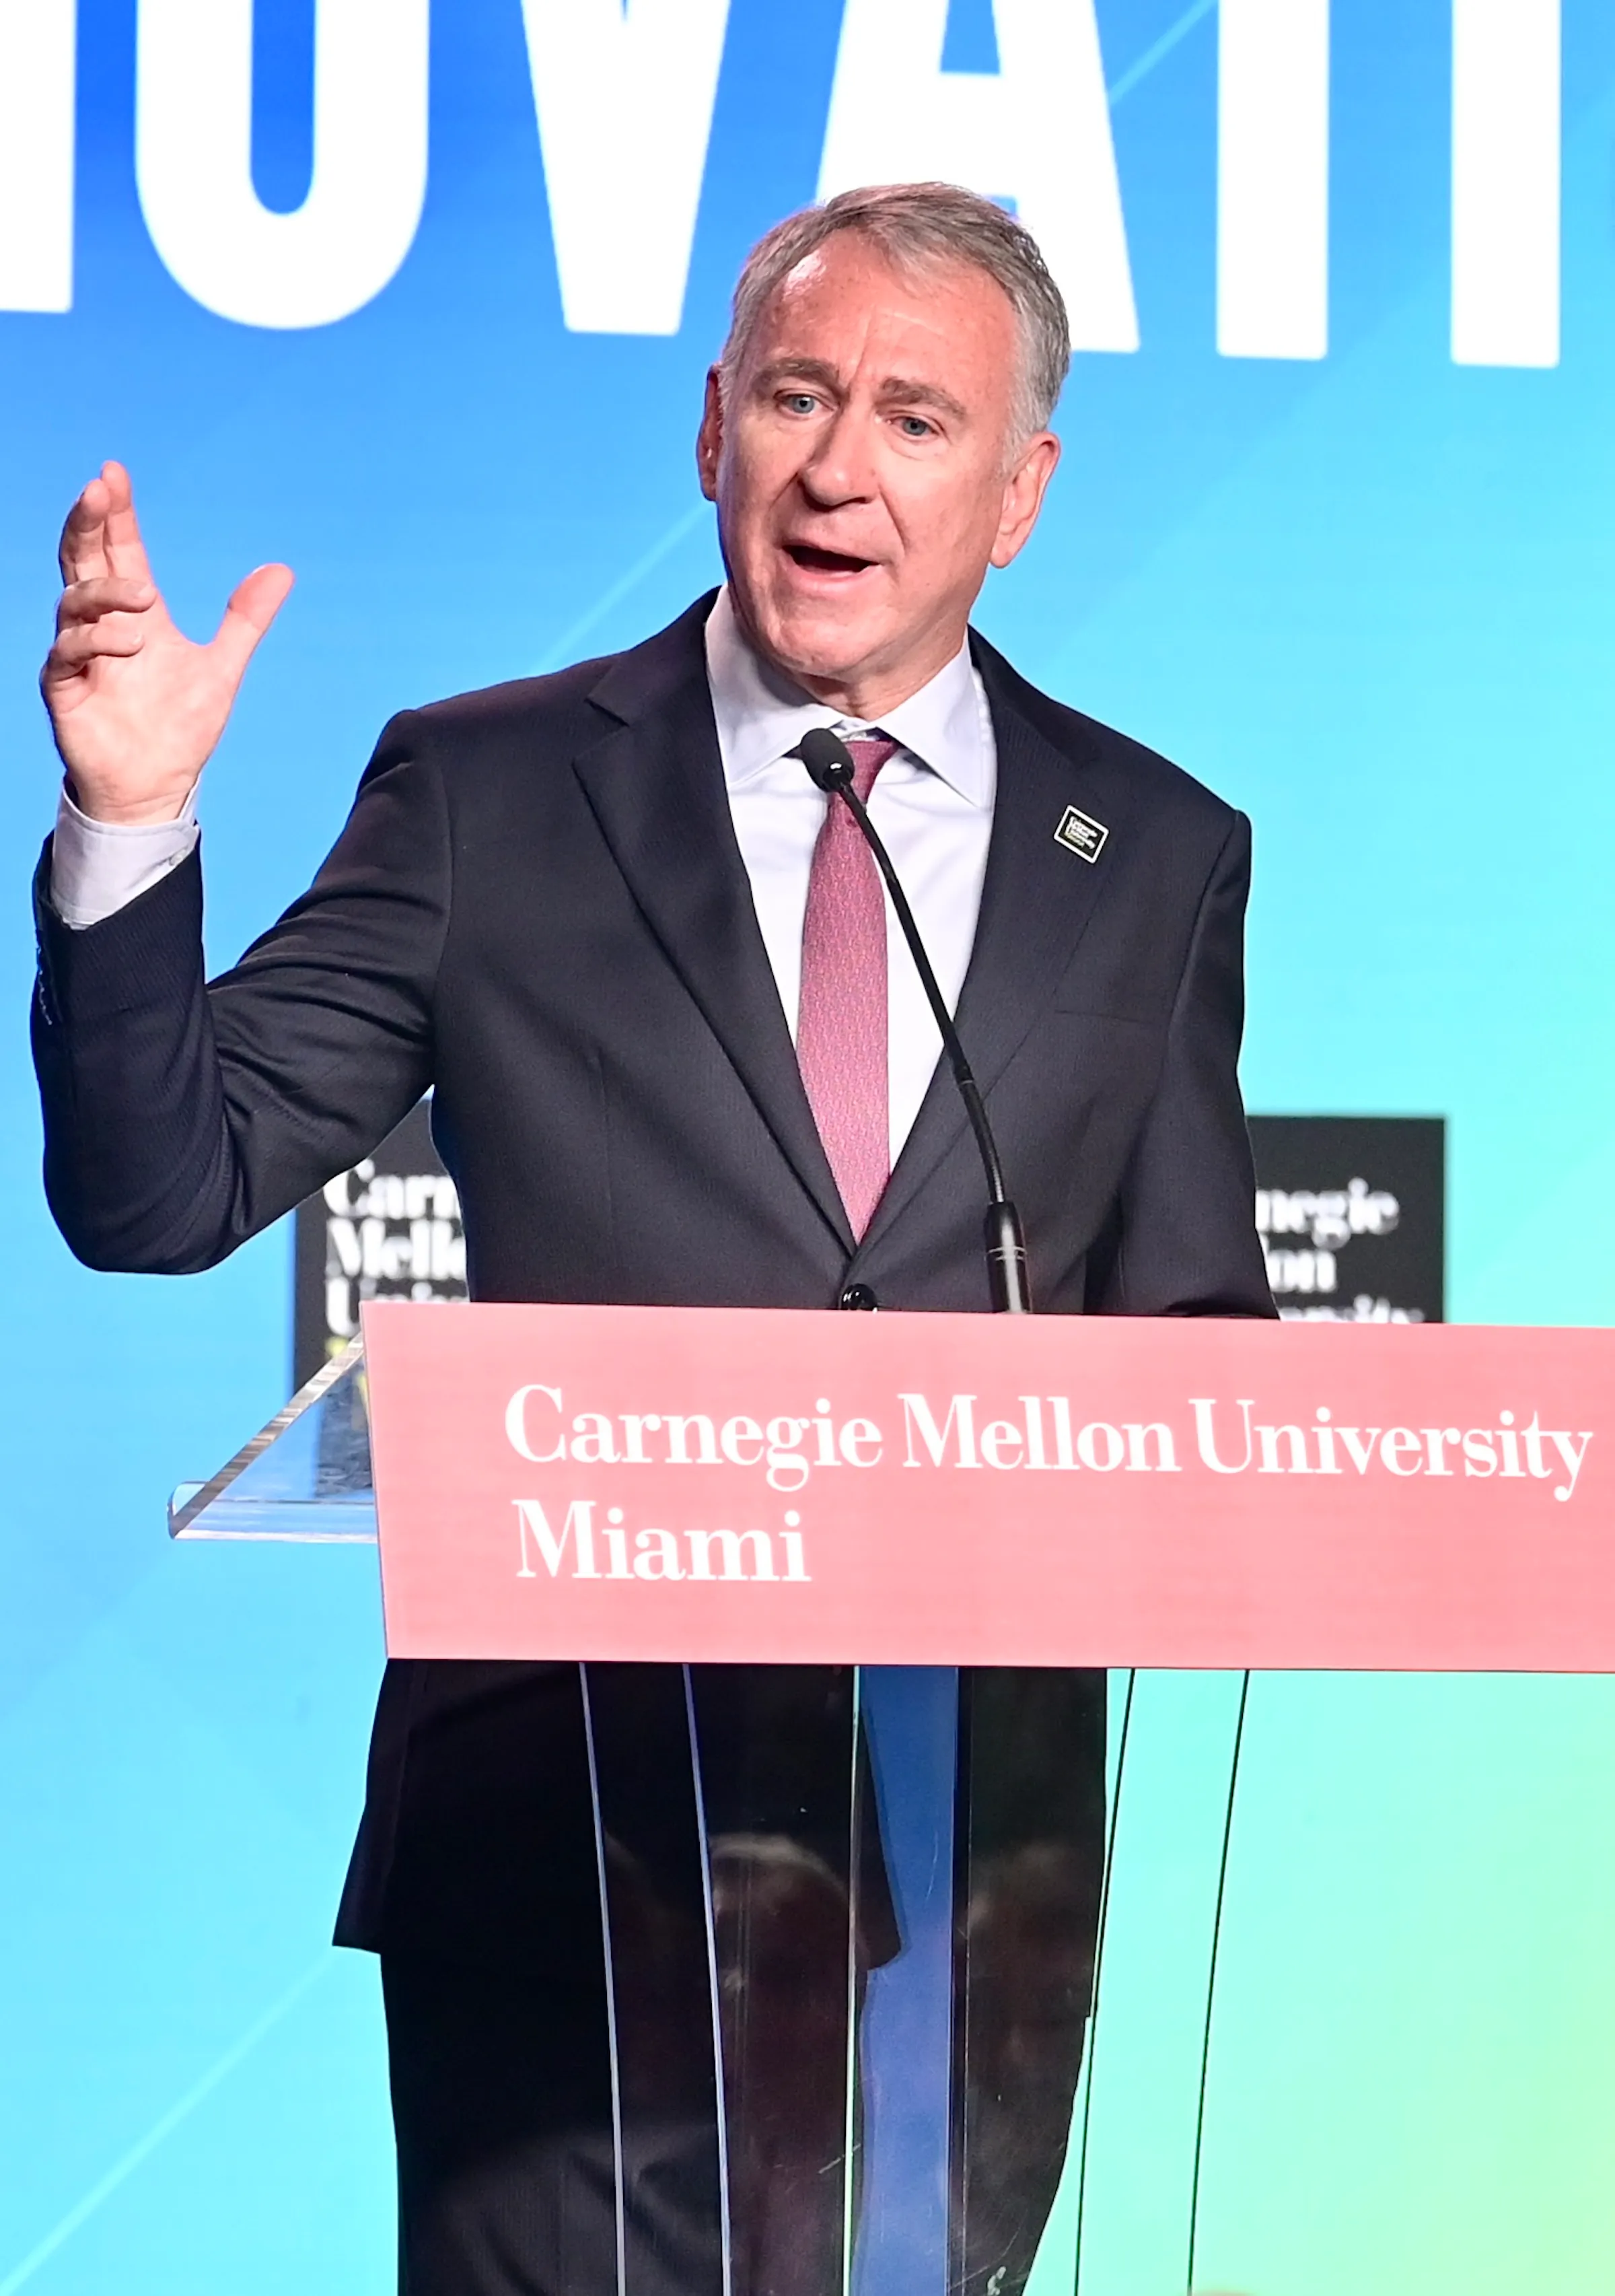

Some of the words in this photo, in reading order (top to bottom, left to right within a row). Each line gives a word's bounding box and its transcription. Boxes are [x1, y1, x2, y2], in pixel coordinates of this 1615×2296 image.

[1260, 1233, 1337, 1294] on
[505, 1384, 883, 1492] Carnegie
[898, 1393, 1182, 1472] Mellon
[1188, 1398, 1593, 1502] University
[512, 1499, 812, 1582] Miami
